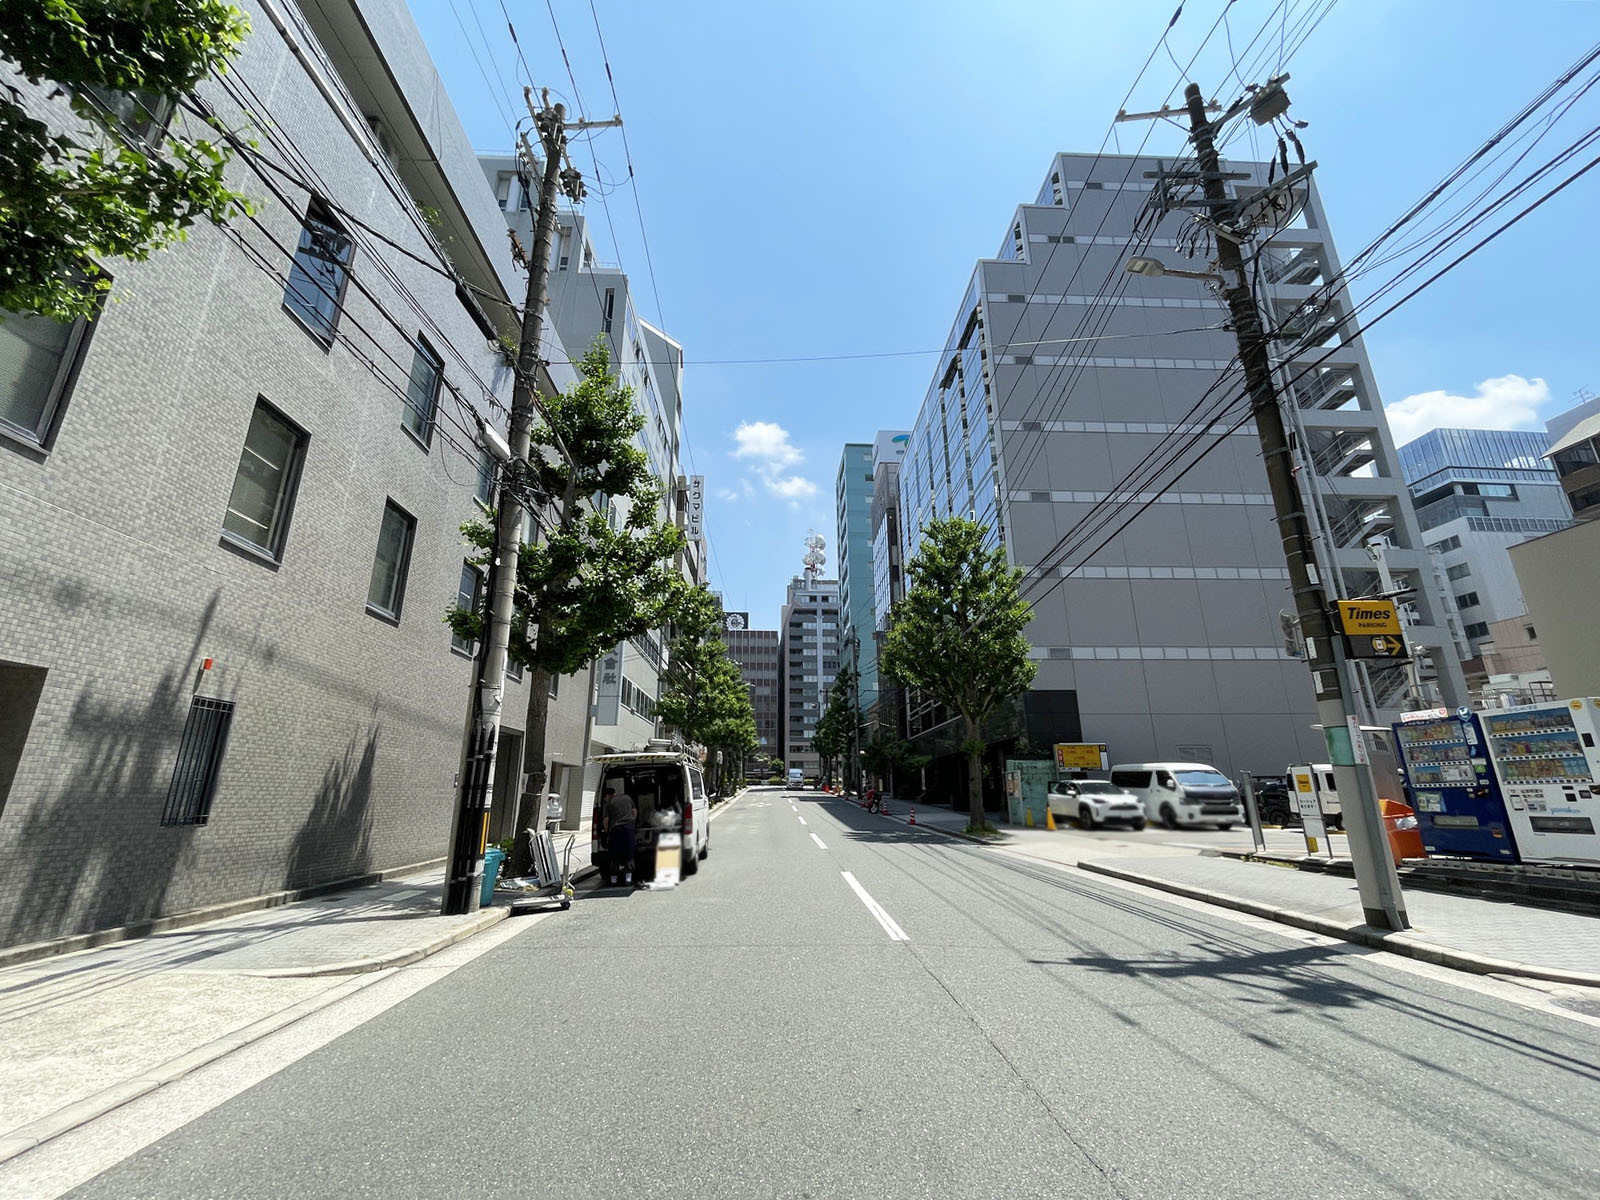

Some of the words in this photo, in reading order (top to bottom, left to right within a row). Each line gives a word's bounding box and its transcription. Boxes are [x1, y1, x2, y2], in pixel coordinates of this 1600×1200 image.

[690, 480, 701, 535] サクマビル
[1347, 607, 1391, 620] Times
